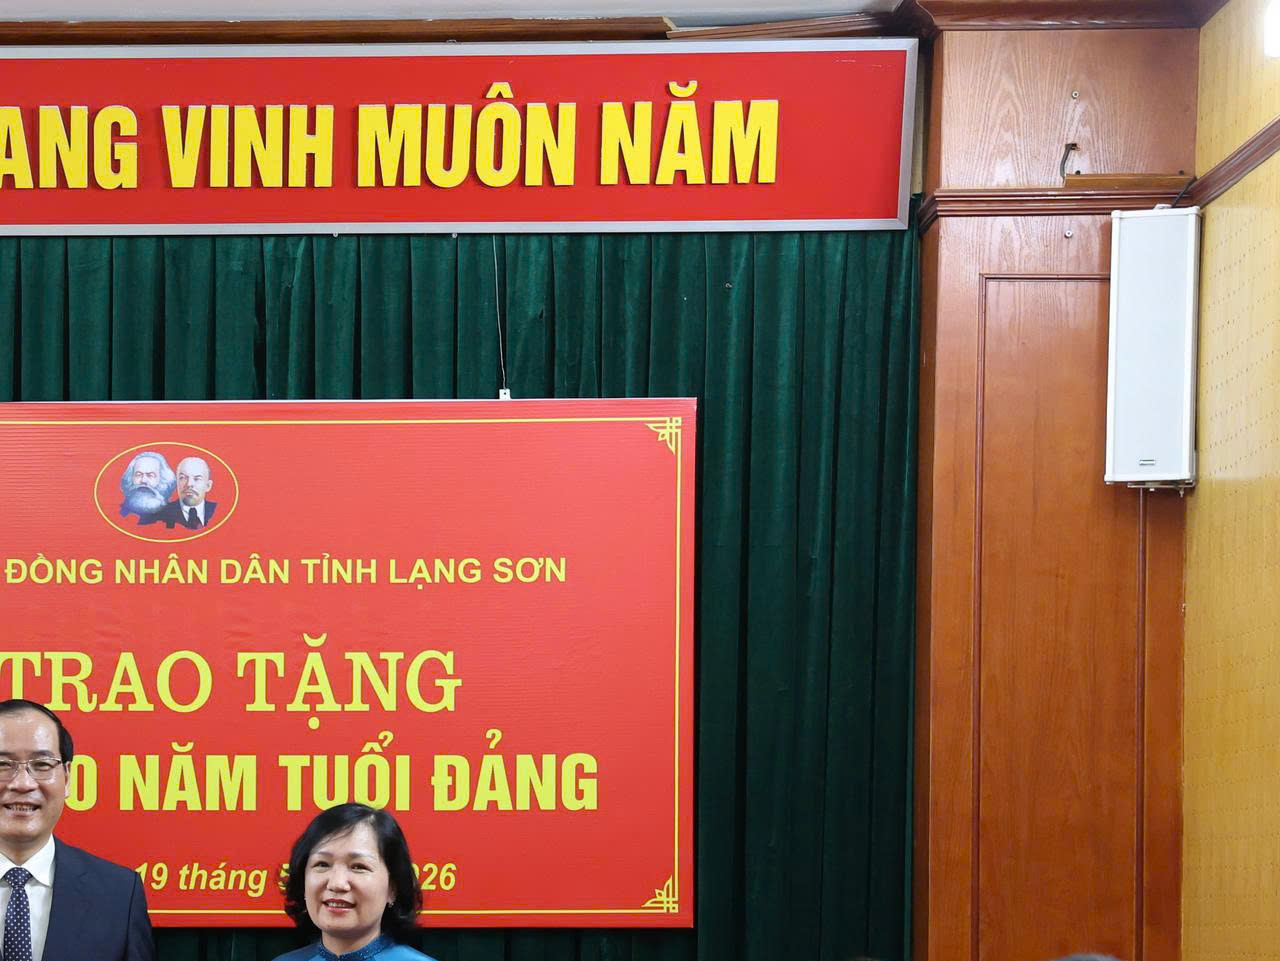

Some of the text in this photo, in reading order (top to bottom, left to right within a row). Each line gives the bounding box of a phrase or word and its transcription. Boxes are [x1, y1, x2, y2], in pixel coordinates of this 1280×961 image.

[162, 104, 335, 189] VINH
[357, 83, 578, 188] MUÔN
[600, 80, 780, 185] NĂM
[5, 553, 104, 585] ĐỒNG
[115, 554, 208, 584] NHÂN
[220, 553, 291, 585] DÂN
[301, 553, 378, 584] TỈNH
[389, 558, 482, 590] LẠNG
[493, 557, 568, 583] SƠN
[237, 633, 464, 735] TẶNG
[64, 754, 99, 812] 0
[120, 742, 258, 811] NĂM
[278, 725, 412, 811] TUỔI
[431, 729, 599, 812] ĐẢNG
[179, 862, 268, 898] tháng
